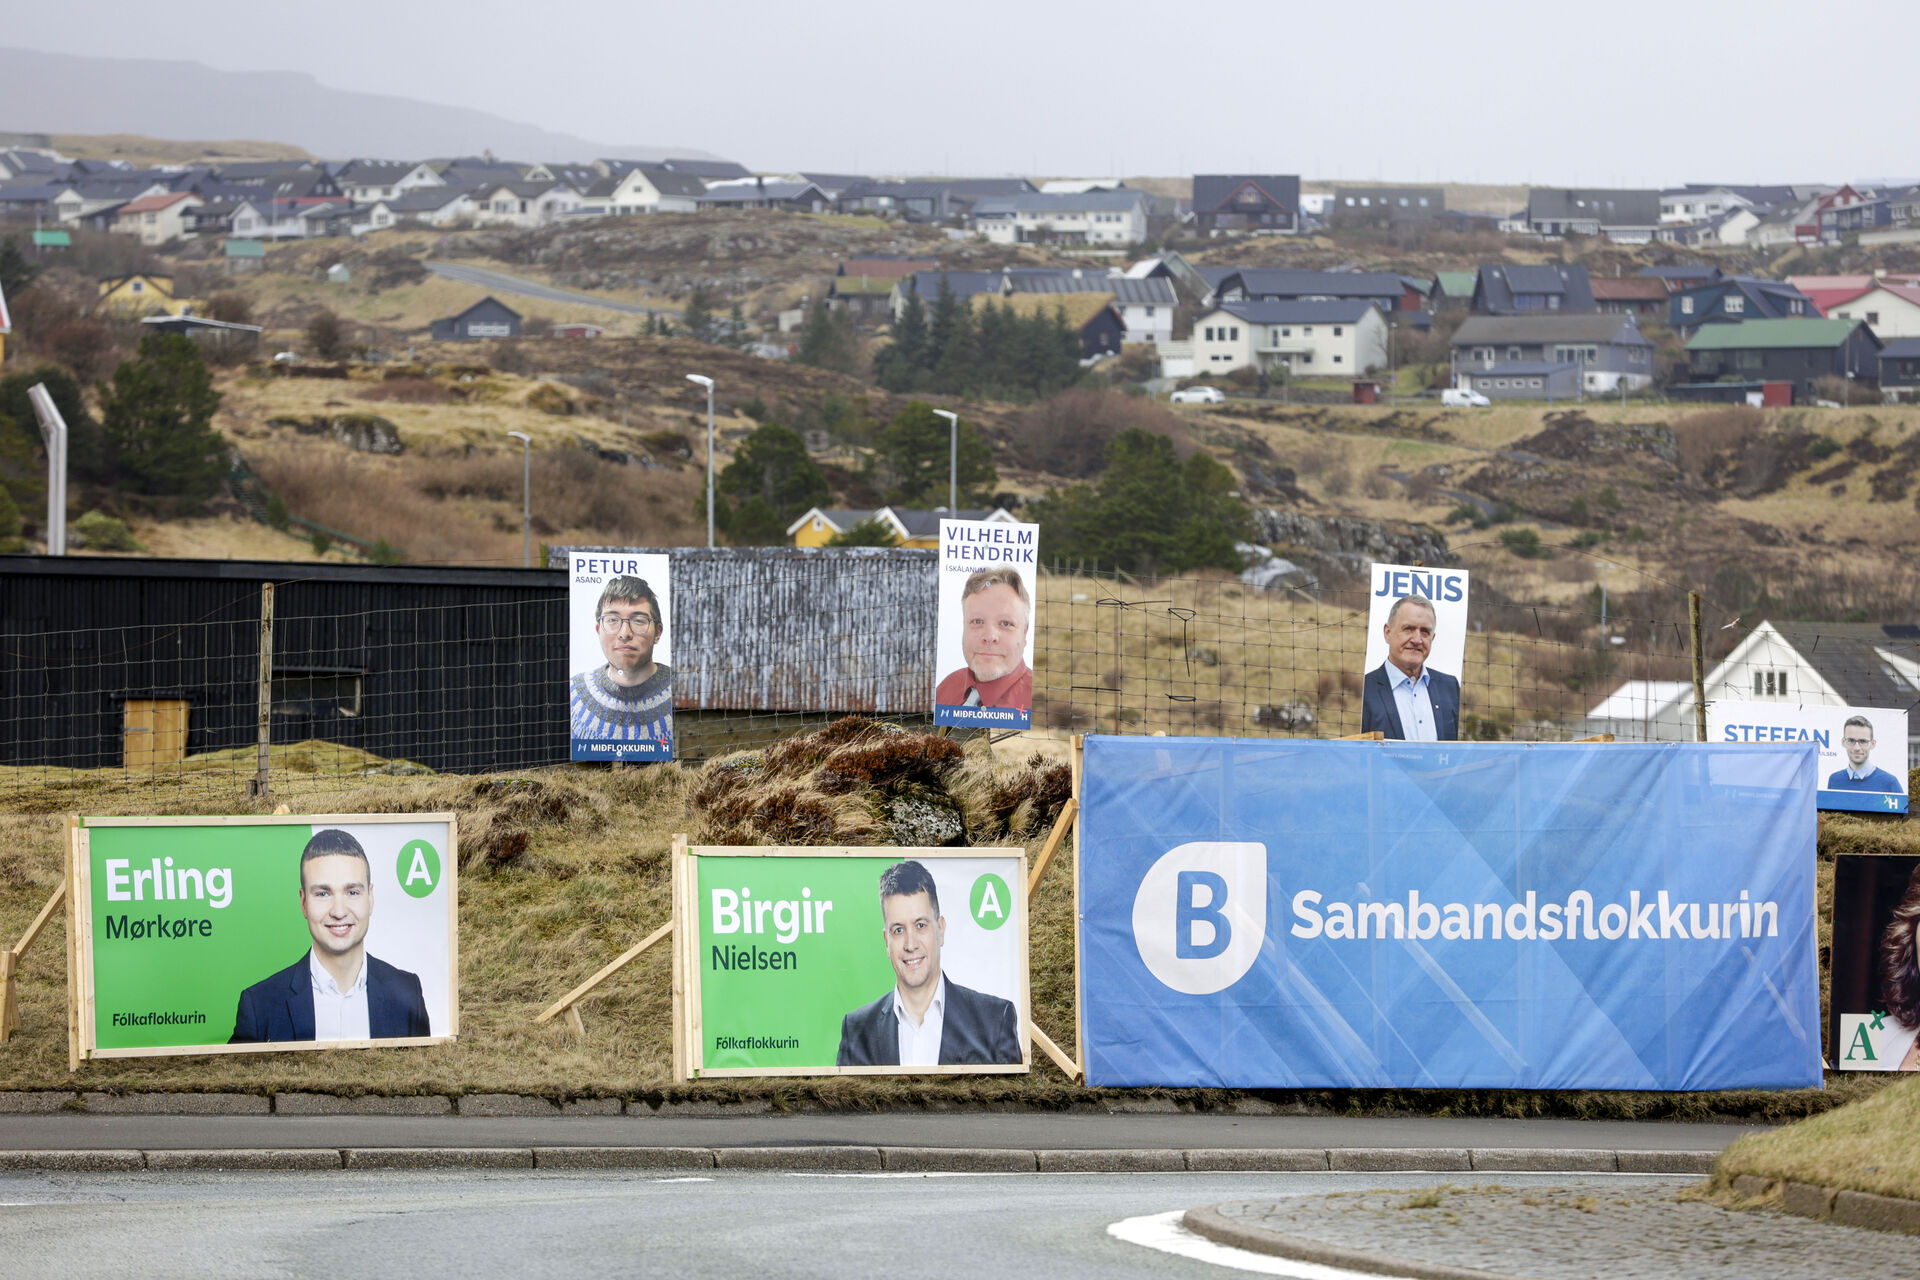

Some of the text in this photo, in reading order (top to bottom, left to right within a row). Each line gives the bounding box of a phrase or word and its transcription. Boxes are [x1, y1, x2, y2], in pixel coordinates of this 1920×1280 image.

[946, 526, 1032, 544] VILHELM
[576, 559, 638, 574] PETUR
[947, 545, 1033, 563] HENDRIK
[575, 576, 602, 584] ASANO
[1375, 571, 1463, 602] JENIS
[953, 710, 1014, 720] MIÐFLOKKURIN
[590, 744, 655, 752] MIÐFLOKKURIN
[405, 847, 433, 886] A
[105, 857, 233, 909] Erling
[977, 881, 1003, 918] A
[106, 914, 213, 940] Mørkøre
[711, 887, 833, 944] Birgir
[1176, 870, 1232, 959] B
[1290, 889, 1779, 939] Sambandsflokkurin
[712, 944, 797, 970] Nielsen
[112, 1010, 206, 1027] Fólkaflokkurin
[716, 1036, 799, 1050] Fólkaflokkurin
[1844, 1022, 1878, 1061] A
